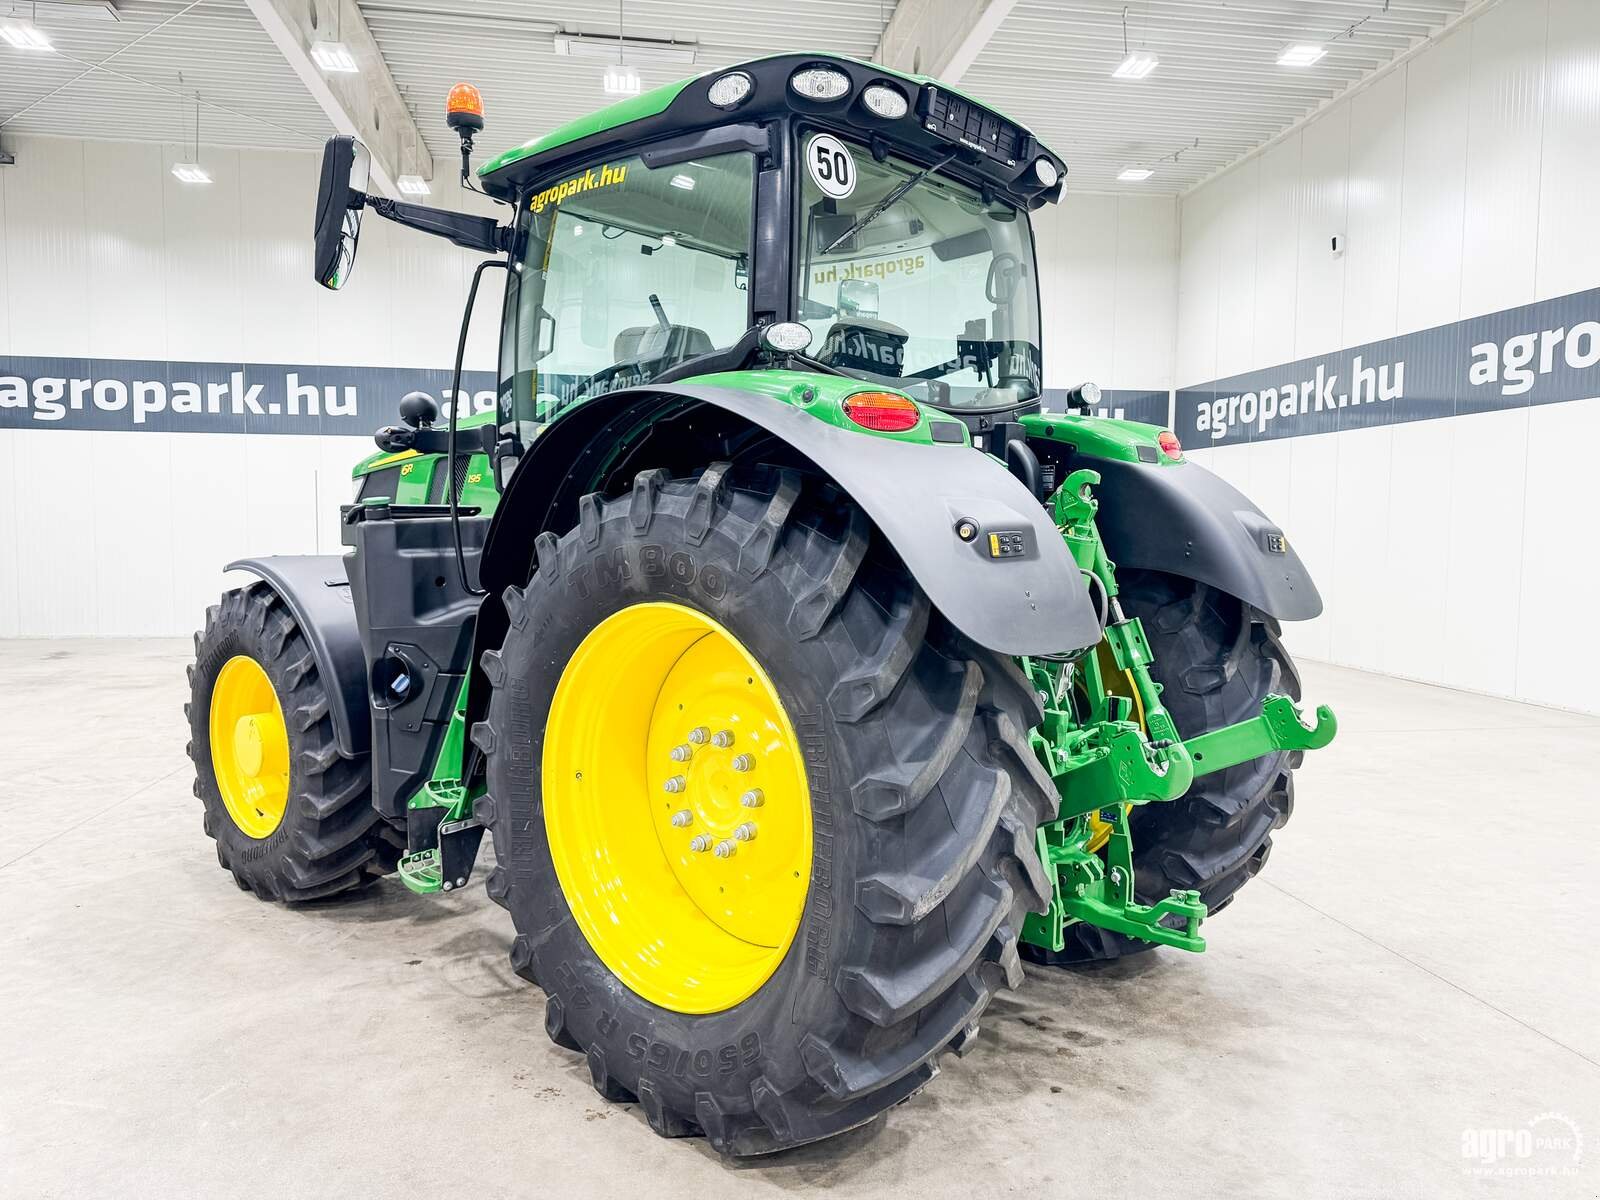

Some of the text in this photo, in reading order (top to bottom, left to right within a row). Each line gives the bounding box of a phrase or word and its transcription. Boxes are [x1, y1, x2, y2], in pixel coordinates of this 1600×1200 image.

[529, 164, 626, 213] agropark.hu
[817, 145, 848, 186] 50
[1469, 321, 1600, 395] agro
[0, 371, 358, 424] agropark.hu
[1196, 355, 1405, 440] agropark.hu
[401, 463, 414, 476] 6R
[566, 544, 727, 601] TM 800
[799, 703, 835, 985] TRELLEBORG
[626, 1031, 762, 1077] 650/65
